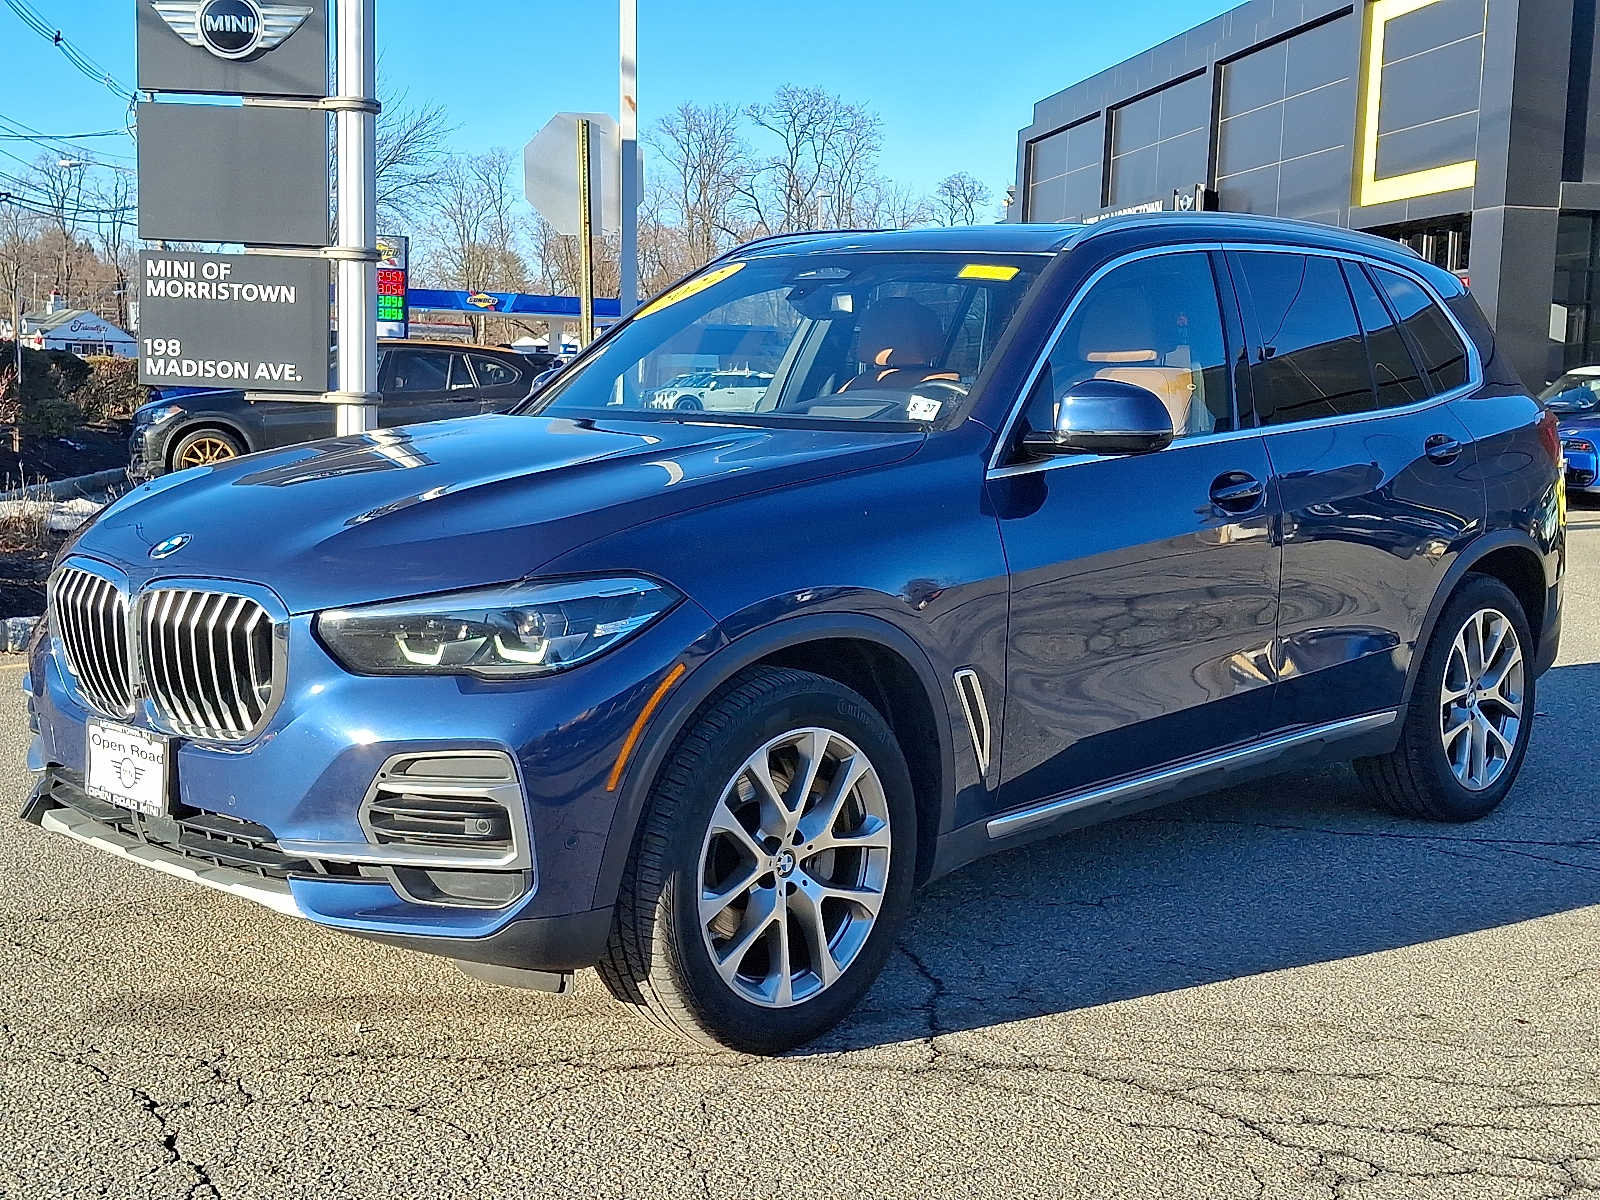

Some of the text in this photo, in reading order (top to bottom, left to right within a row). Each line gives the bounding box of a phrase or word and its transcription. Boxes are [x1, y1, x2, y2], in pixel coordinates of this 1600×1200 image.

[205, 14, 254, 33] MINI
[146, 259, 232, 280] MINI OF
[146, 279, 297, 304] MORRISTOWN
[143, 338, 182, 357] 198
[145, 358, 303, 382] MADISON AVE.
[92, 733, 164, 765] Open Road
[88, 786, 160, 817] OPEN ROAD MINI
